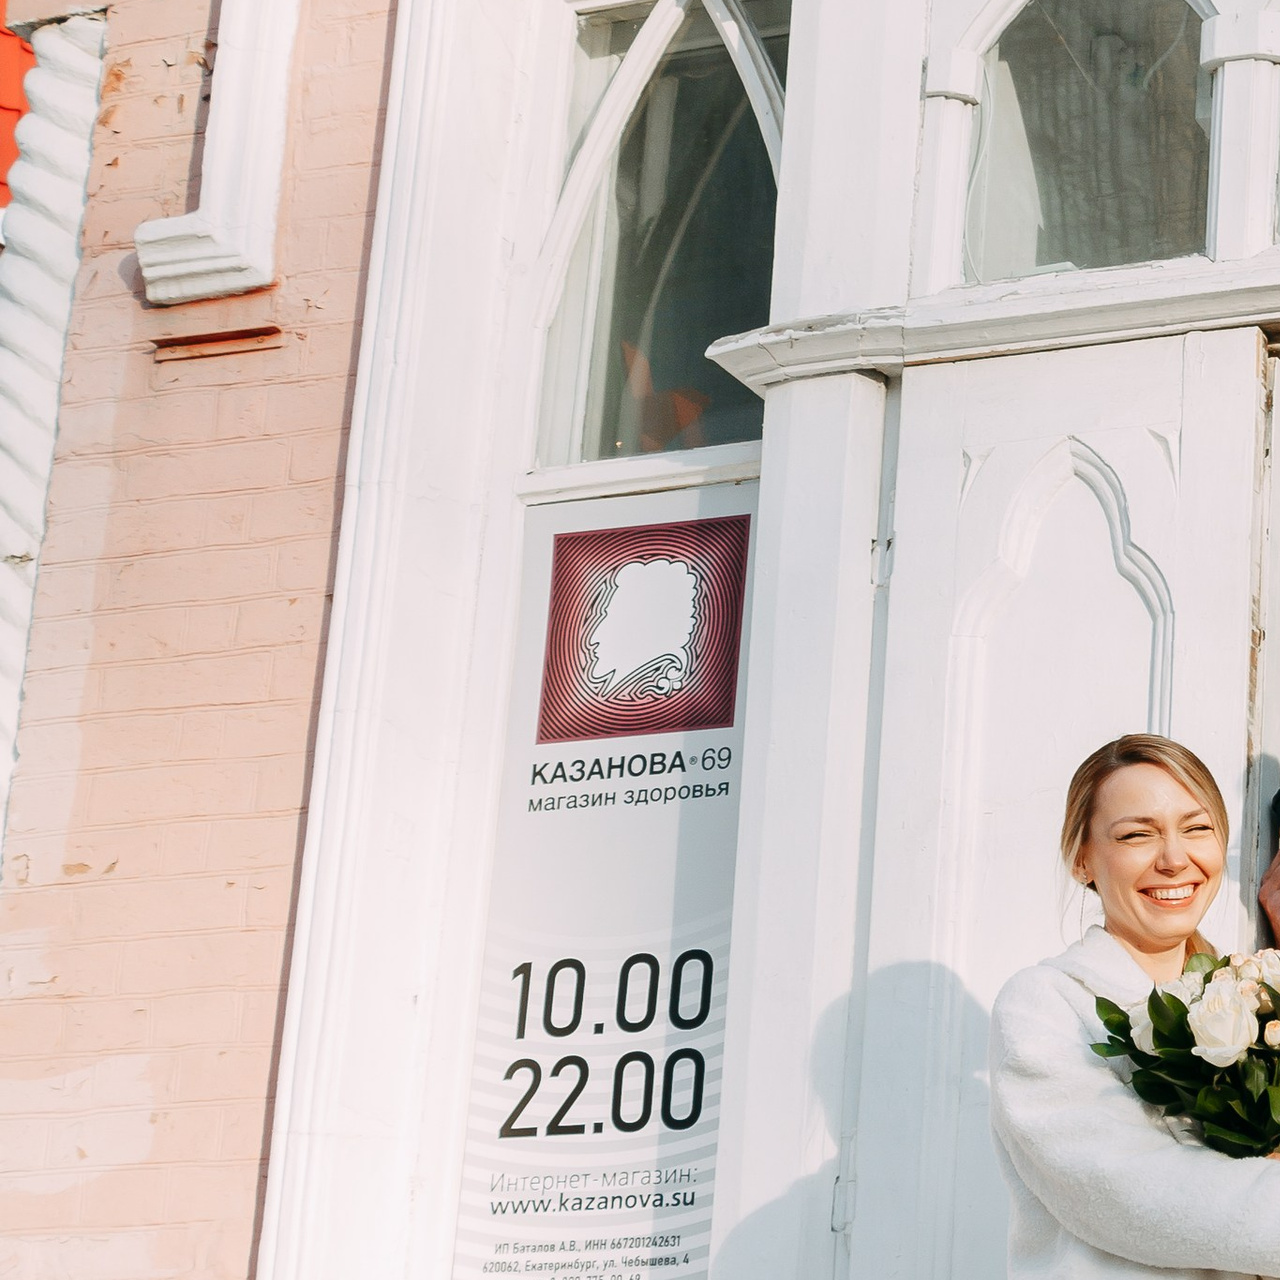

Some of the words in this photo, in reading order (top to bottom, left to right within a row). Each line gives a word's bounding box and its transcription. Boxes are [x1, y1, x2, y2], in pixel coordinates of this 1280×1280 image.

[531, 750, 687, 786] КАЗАНОВА
[701, 746, 732, 771] 69
[528, 791, 616, 813] магазин
[623, 781, 730, 805] здоровья
[511, 948, 714, 1040] 10.00
[498, 1047, 706, 1139] 22.00
[490, 1167, 698, 1196] Интернет-магазин:
[490, 1190, 696, 1215] www.kazanova.su
[494, 1243, 509, 1254] ИП
[513, 1240, 555, 1255] Баталов
[585, 1237, 607, 1251] ИНН
[610, 1235, 681, 1250] 667201242631
[482, 1261, 521, 1274] 620062,
[525, 1257, 599, 1275] Екатеринбург,
[621, 1254, 680, 1269] Чебышева,
[683, 1253, 689, 1265] 4
